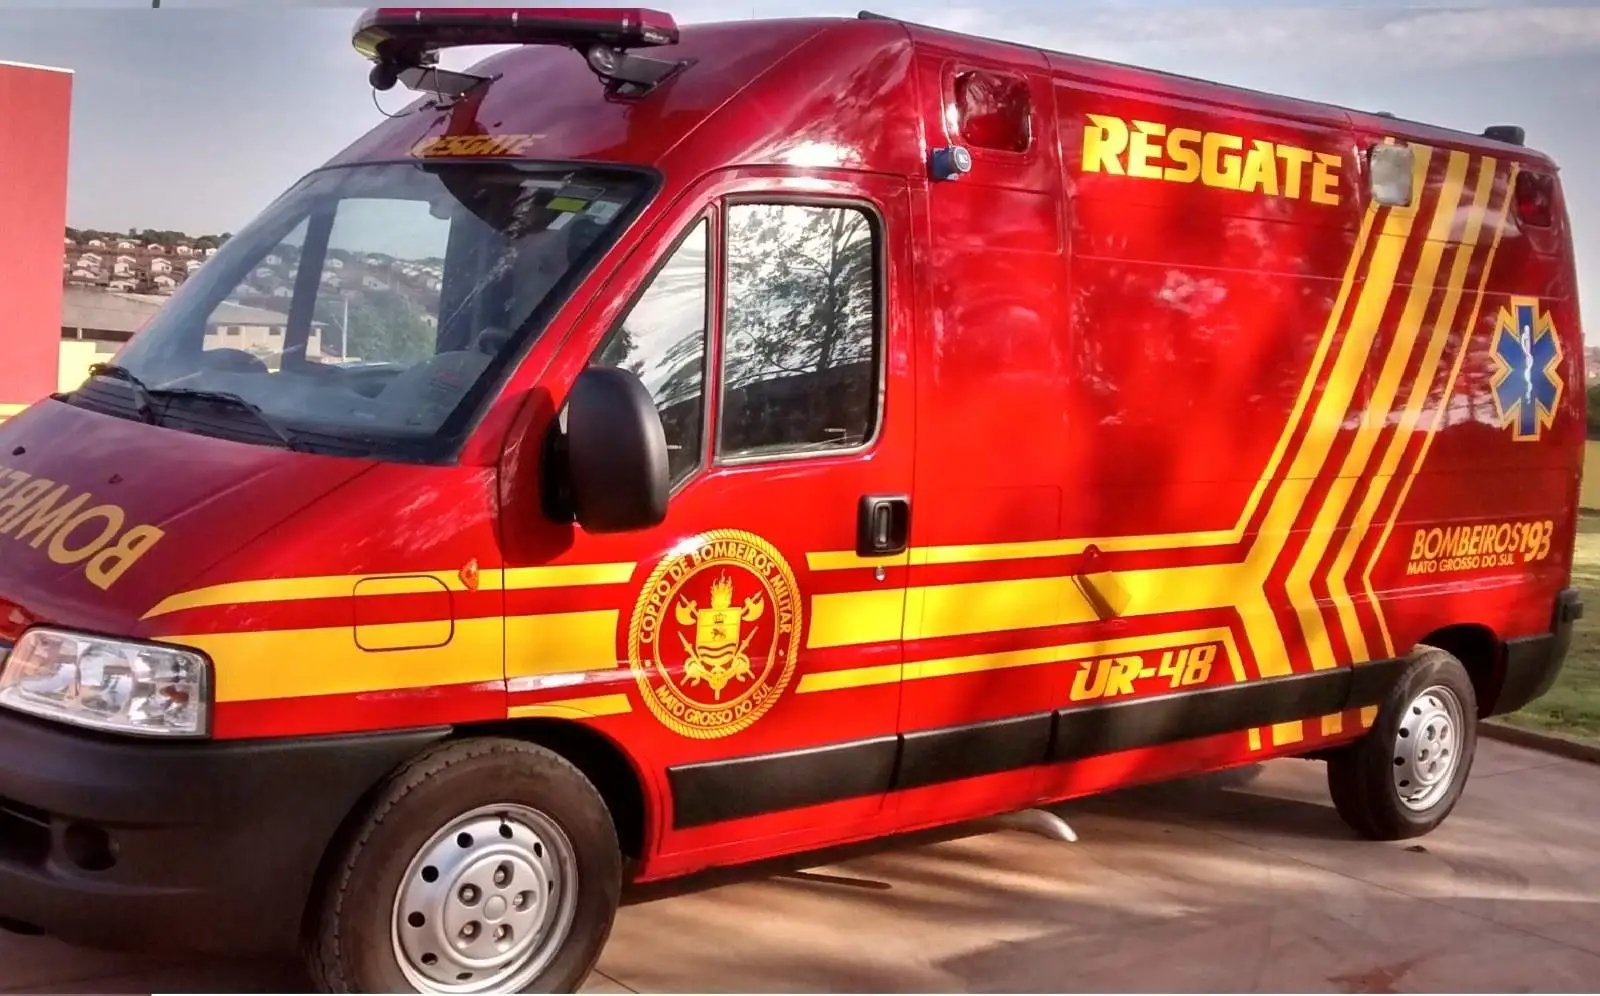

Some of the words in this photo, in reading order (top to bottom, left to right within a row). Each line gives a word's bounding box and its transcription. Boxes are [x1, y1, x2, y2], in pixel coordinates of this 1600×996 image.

[1082, 113, 1342, 206] RESGATE
[1406, 560, 1437, 575] MATO
[1439, 555, 1480, 571] GROSSO
[1482, 554, 1497, 568] DO
[1498, 552, 1515, 566] SUL
[1410, 522, 1522, 561] BOMBEIROS
[1519, 520, 1554, 562] 193
[669, 556, 691, 582] DE
[692, 541, 775, 577] BOMBEIROS
[770, 574, 792, 635] MILITAR
[1069, 645, 1217, 701] UR-48
[655, 684, 685, 716] MATO
[684, 708, 733, 726] GROSSO
[735, 699, 752, 719] DO
[752, 682, 773, 705] SUL
